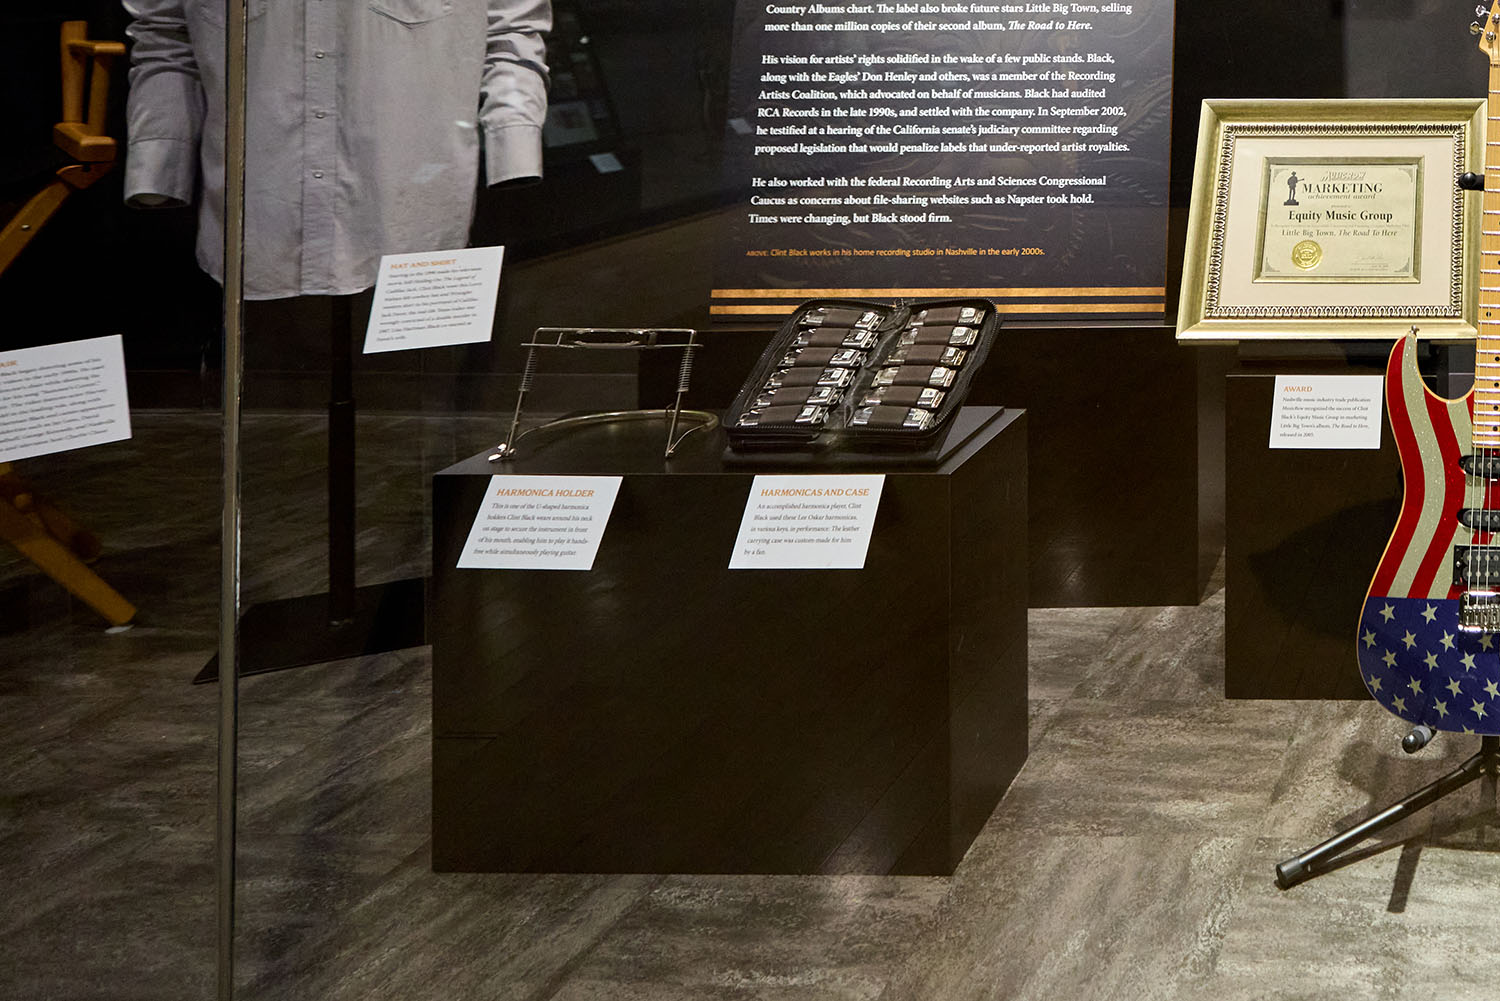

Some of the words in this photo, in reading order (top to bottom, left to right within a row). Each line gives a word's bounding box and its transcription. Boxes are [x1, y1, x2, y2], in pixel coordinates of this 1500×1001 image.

[1303, 183, 1382, 193] MARKETING
[748, 213, 778, 223] Times
[803, 213, 851, 225] changing,
[853, 212, 869, 222] but
[871, 212, 898, 222] Black
[899, 212, 926, 222] stood
[928, 212, 952, 222] firm.
[1289, 210, 1320, 223] Equity
[1326, 210, 1356, 219] Music
[1360, 211, 1392, 222] Group
[1283, 385, 1313, 393] AWARD
[496, 488, 554, 497] HARMONICA
[555, 488, 595, 497] HOLDER
[761, 488, 823, 497] HARMONICAS
[823, 488, 844, 497] AND
[845, 488, 870, 497] CASE
